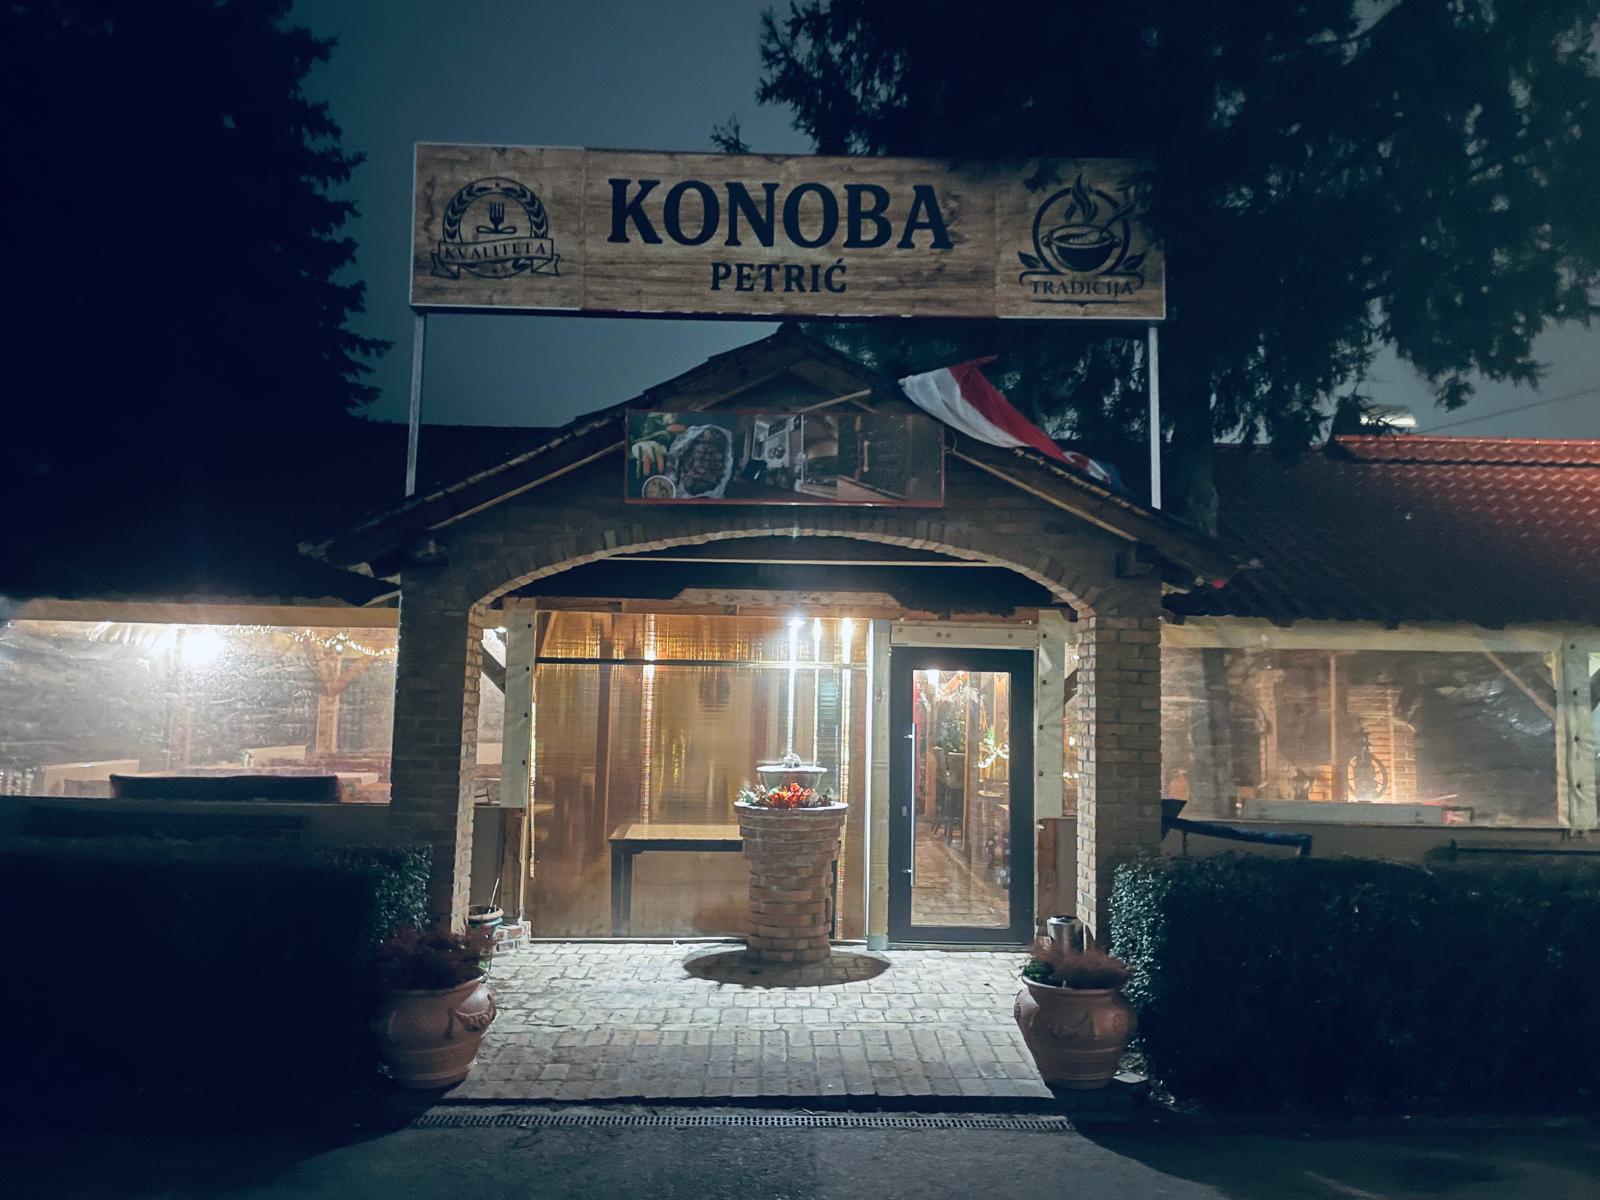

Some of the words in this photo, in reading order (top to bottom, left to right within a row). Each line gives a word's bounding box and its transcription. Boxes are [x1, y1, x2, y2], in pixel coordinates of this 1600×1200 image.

[607, 179, 953, 248] KONOBA
[443, 241, 546, 260] KVALITETA
[711, 258, 847, 293] PETRIĆ
[1031, 280, 1134, 297] TRADICIJA
